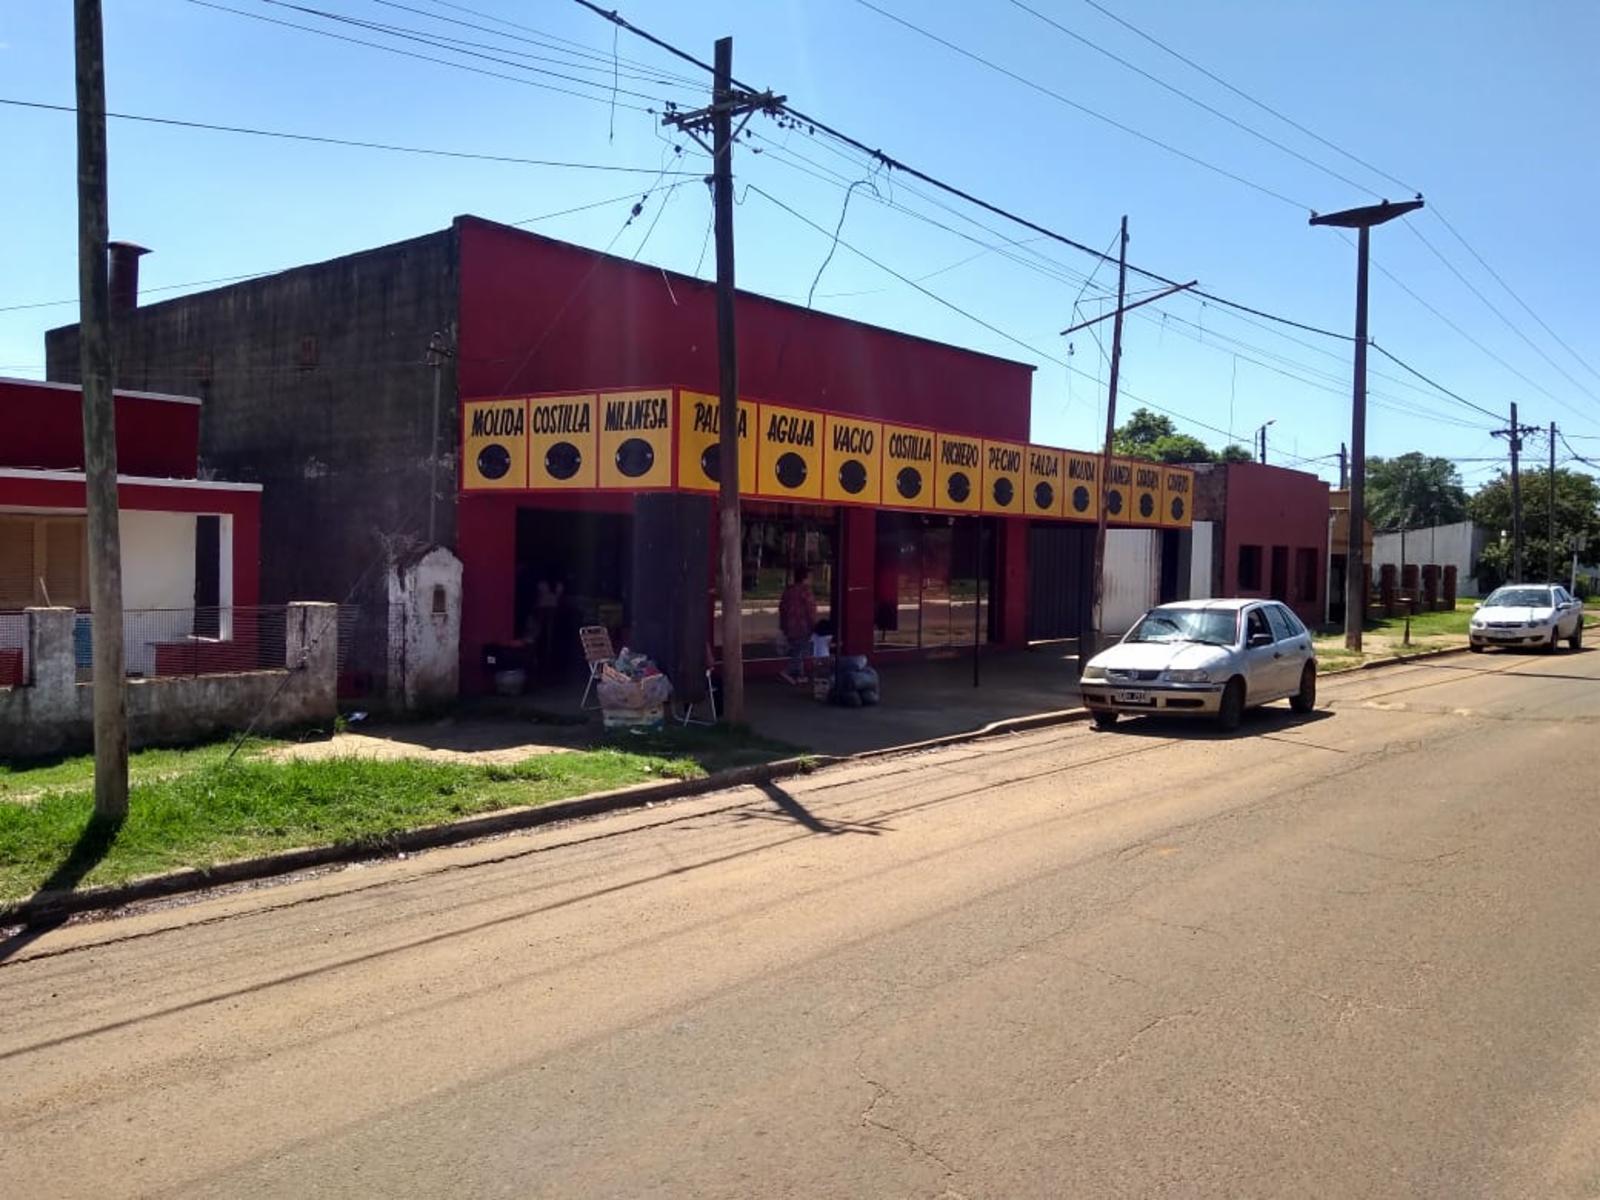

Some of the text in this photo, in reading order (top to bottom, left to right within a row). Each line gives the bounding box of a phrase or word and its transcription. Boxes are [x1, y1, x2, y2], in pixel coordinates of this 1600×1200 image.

[472, 407, 524, 437] MOLIDA
[533, 402, 590, 434] COSTILLA
[604, 398, 668, 431] MILANESA
[694, 402, 747, 439] PALA
[767, 414, 815, 447] AGUJA
[833, 424, 874, 456] VACIO
[889, 432, 932, 462] COSTILLA
[989, 447, 1021, 473] PECHO
[1030, 453, 1058, 478] FALDA
